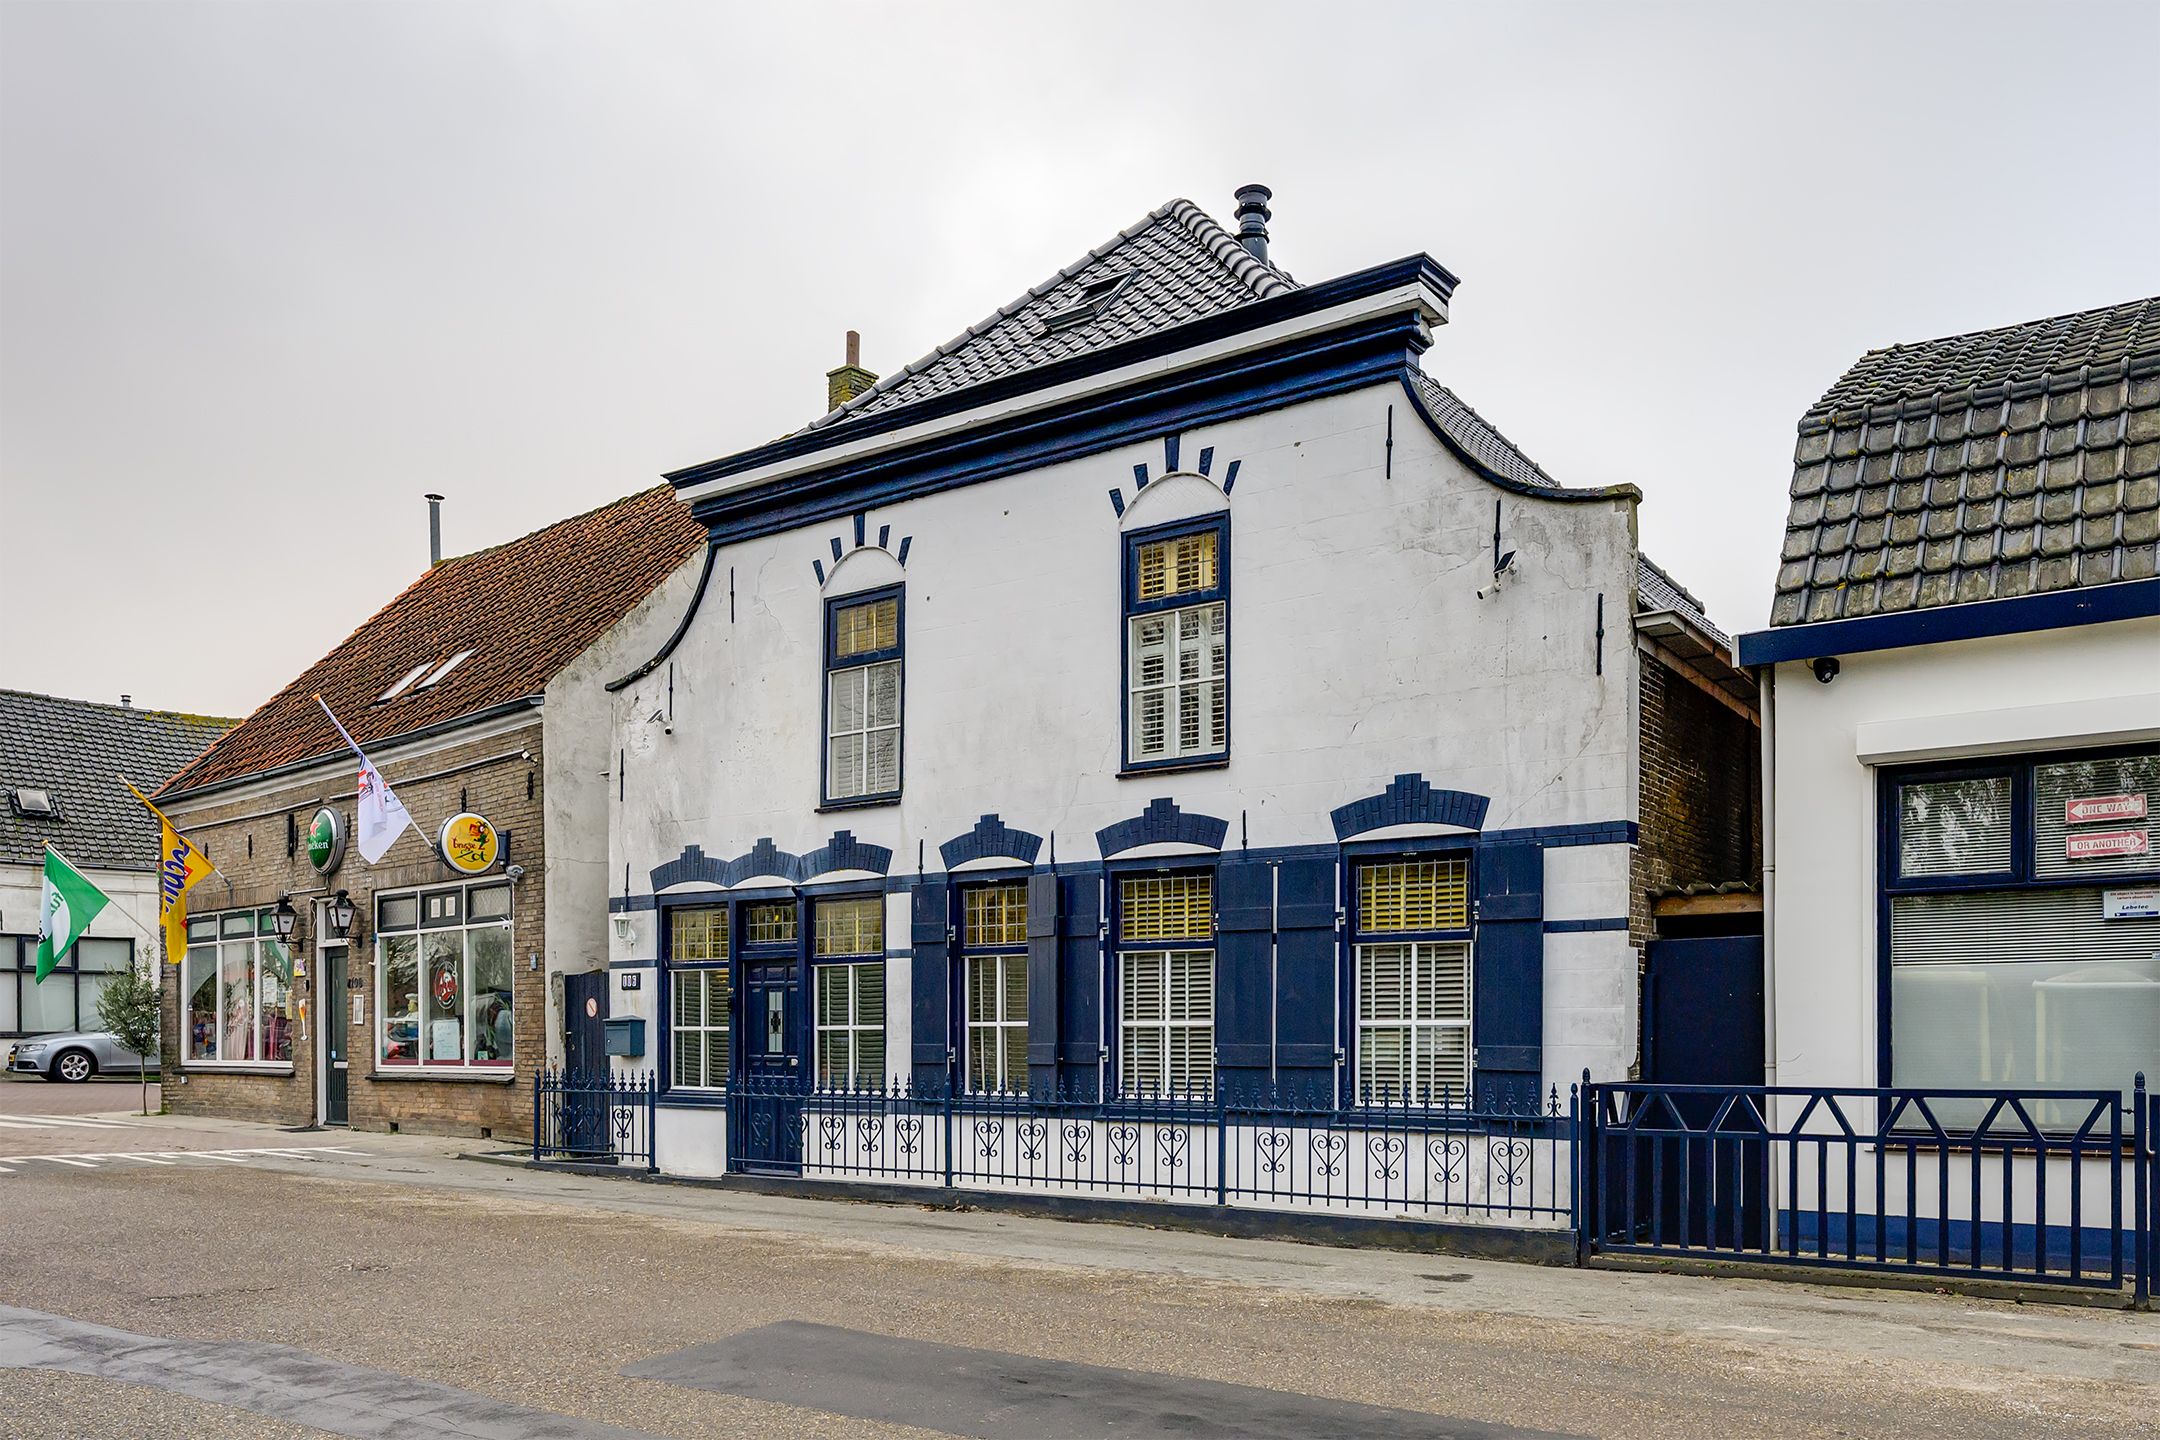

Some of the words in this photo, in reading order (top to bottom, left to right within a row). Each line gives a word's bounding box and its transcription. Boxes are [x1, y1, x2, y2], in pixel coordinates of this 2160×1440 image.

[2082, 804, 2103, 814] ONE
[2106, 802, 2130, 812] WAY
[2077, 841, 2090, 850] OR
[2092, 837, 2136, 849] ANOTHER
